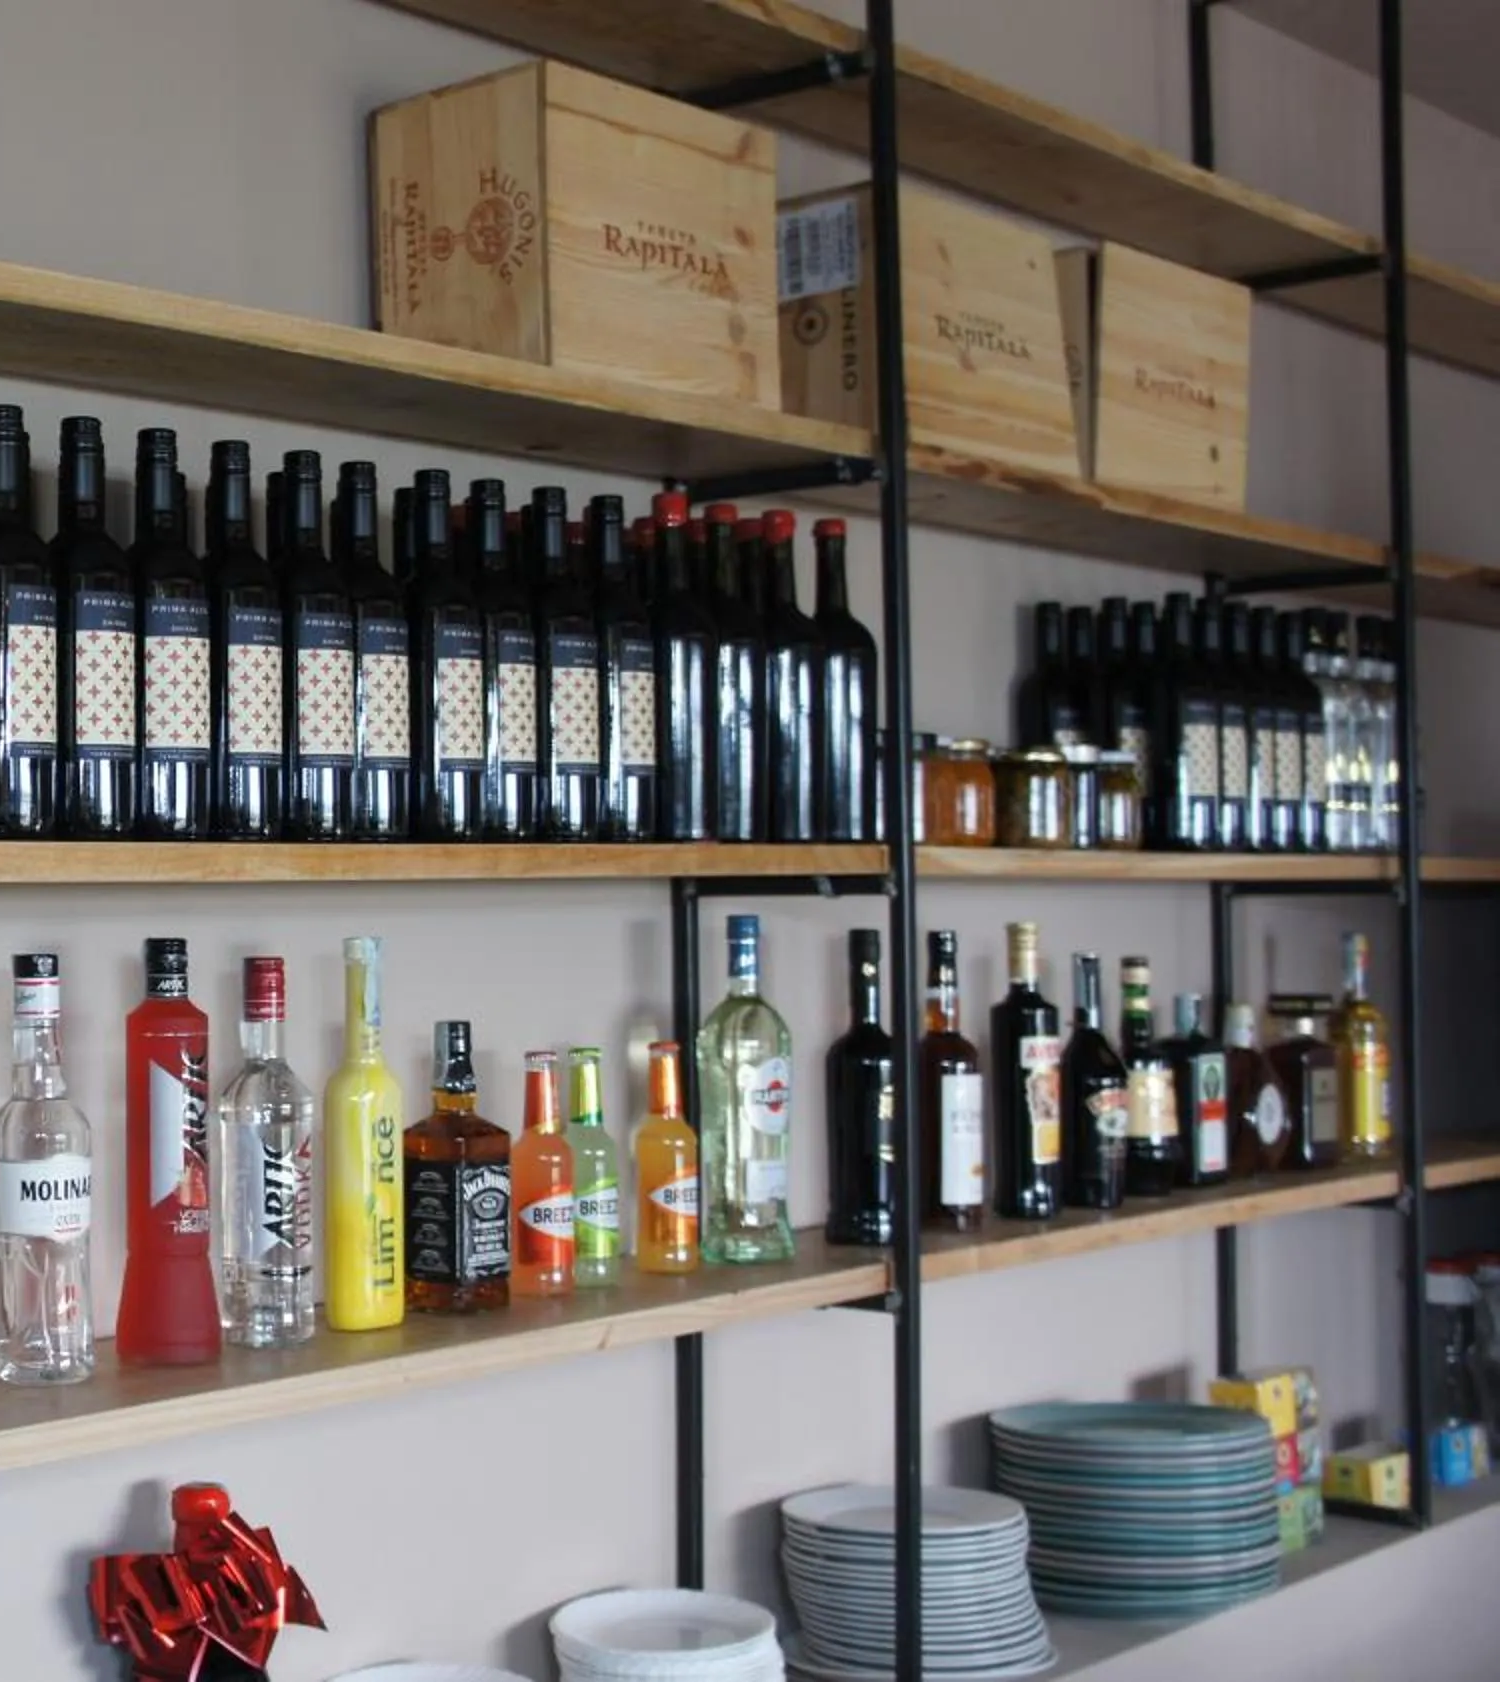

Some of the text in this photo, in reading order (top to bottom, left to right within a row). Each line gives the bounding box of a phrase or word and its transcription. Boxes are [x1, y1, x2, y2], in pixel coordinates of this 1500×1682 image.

[478, 166, 536, 286] HUGONIS
[19, 1174, 91, 1202] MOLINA
[262, 1141, 293, 1249] ARTIC
